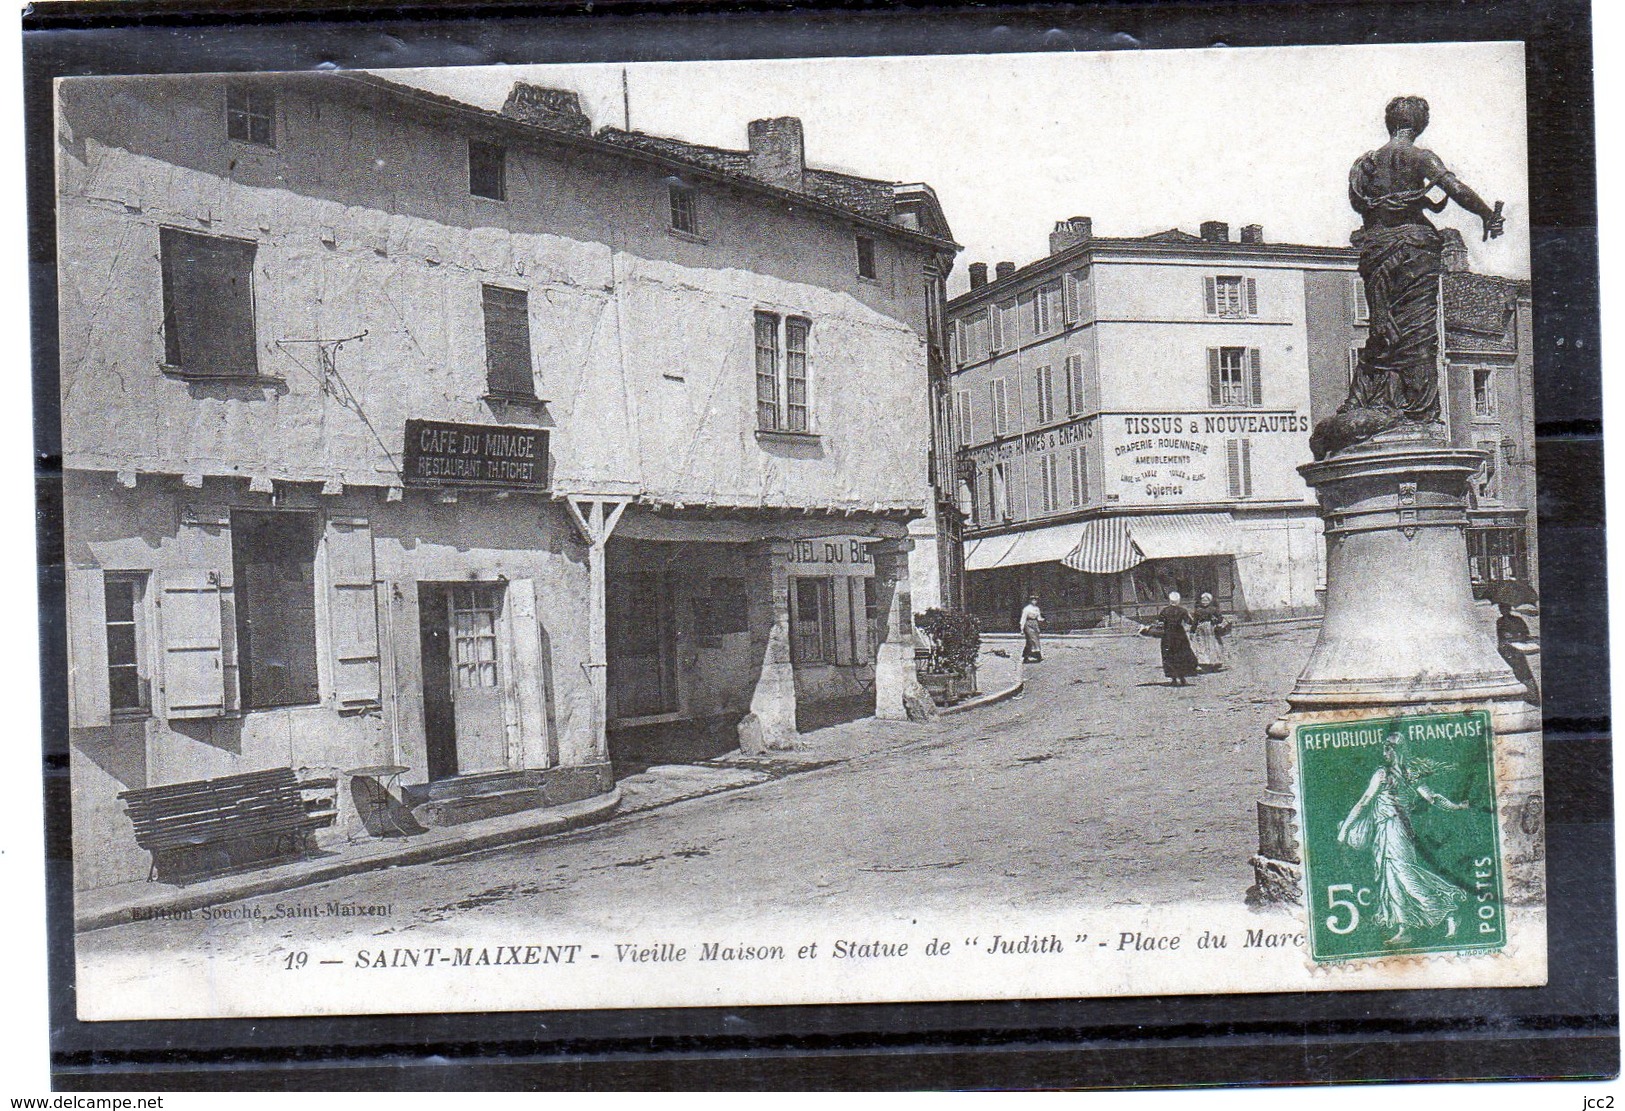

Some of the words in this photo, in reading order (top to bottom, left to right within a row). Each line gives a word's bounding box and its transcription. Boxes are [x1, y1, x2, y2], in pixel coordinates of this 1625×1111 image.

[1049, 434, 1055, 448] &
[1060, 422, 1093, 446] ENFANTS
[1125, 417, 1183, 434] TISSUS
[462, 434, 479, 455] DU
[485, 434, 535, 458] MINAGE
[1115, 439, 1153, 457] DRAPERIE
[1158, 438, 1208, 455] ROUENNERIE
[418, 457, 481, 477] RESTAURANT
[824, 543, 844, 563] DU
[1408, 720, 1482, 741] FRANÇAISE
[1474, 856, 1496, 934] POSTES
